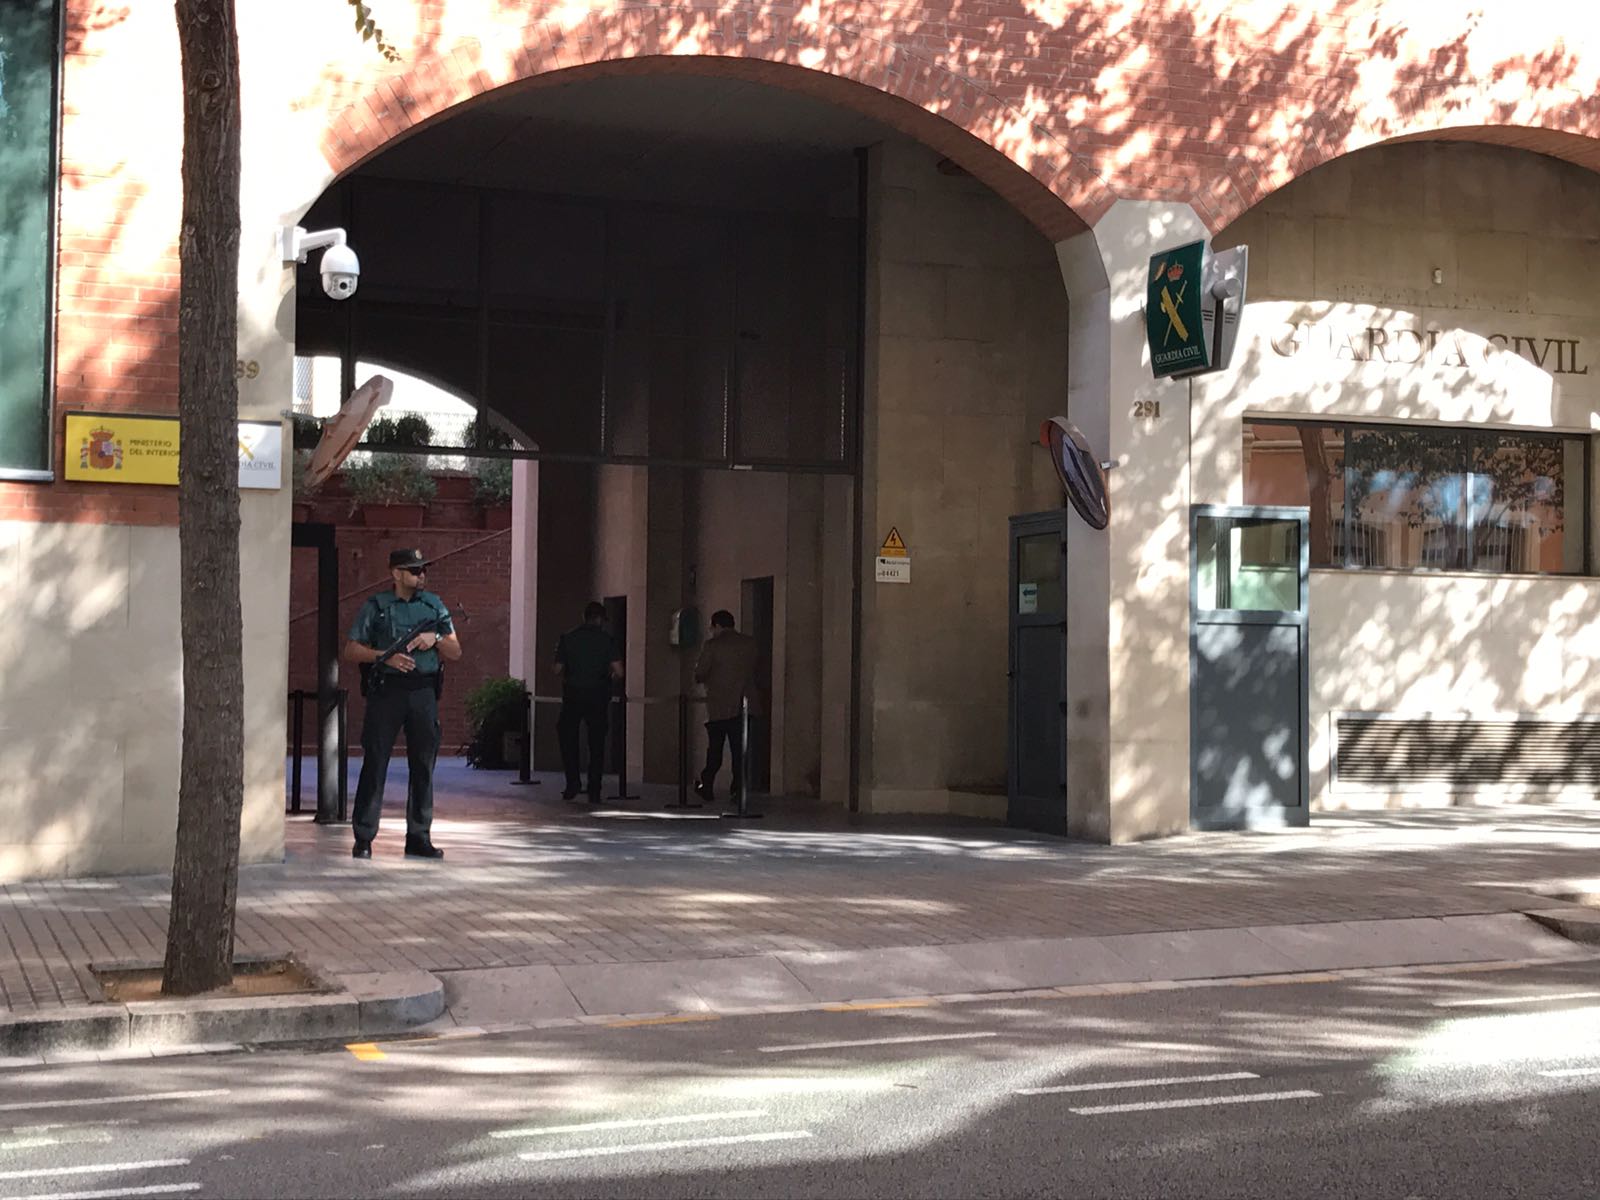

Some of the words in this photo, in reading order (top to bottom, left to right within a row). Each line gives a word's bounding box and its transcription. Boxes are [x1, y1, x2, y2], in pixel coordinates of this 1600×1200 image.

[1155, 348, 1183, 363] GUARDIA
[1183, 345, 1201, 357] CIVIL
[1483, 333, 1588, 375] CIVIL
[1134, 401, 1160, 417] 291
[130, 439, 172, 448] MINISTERIO
